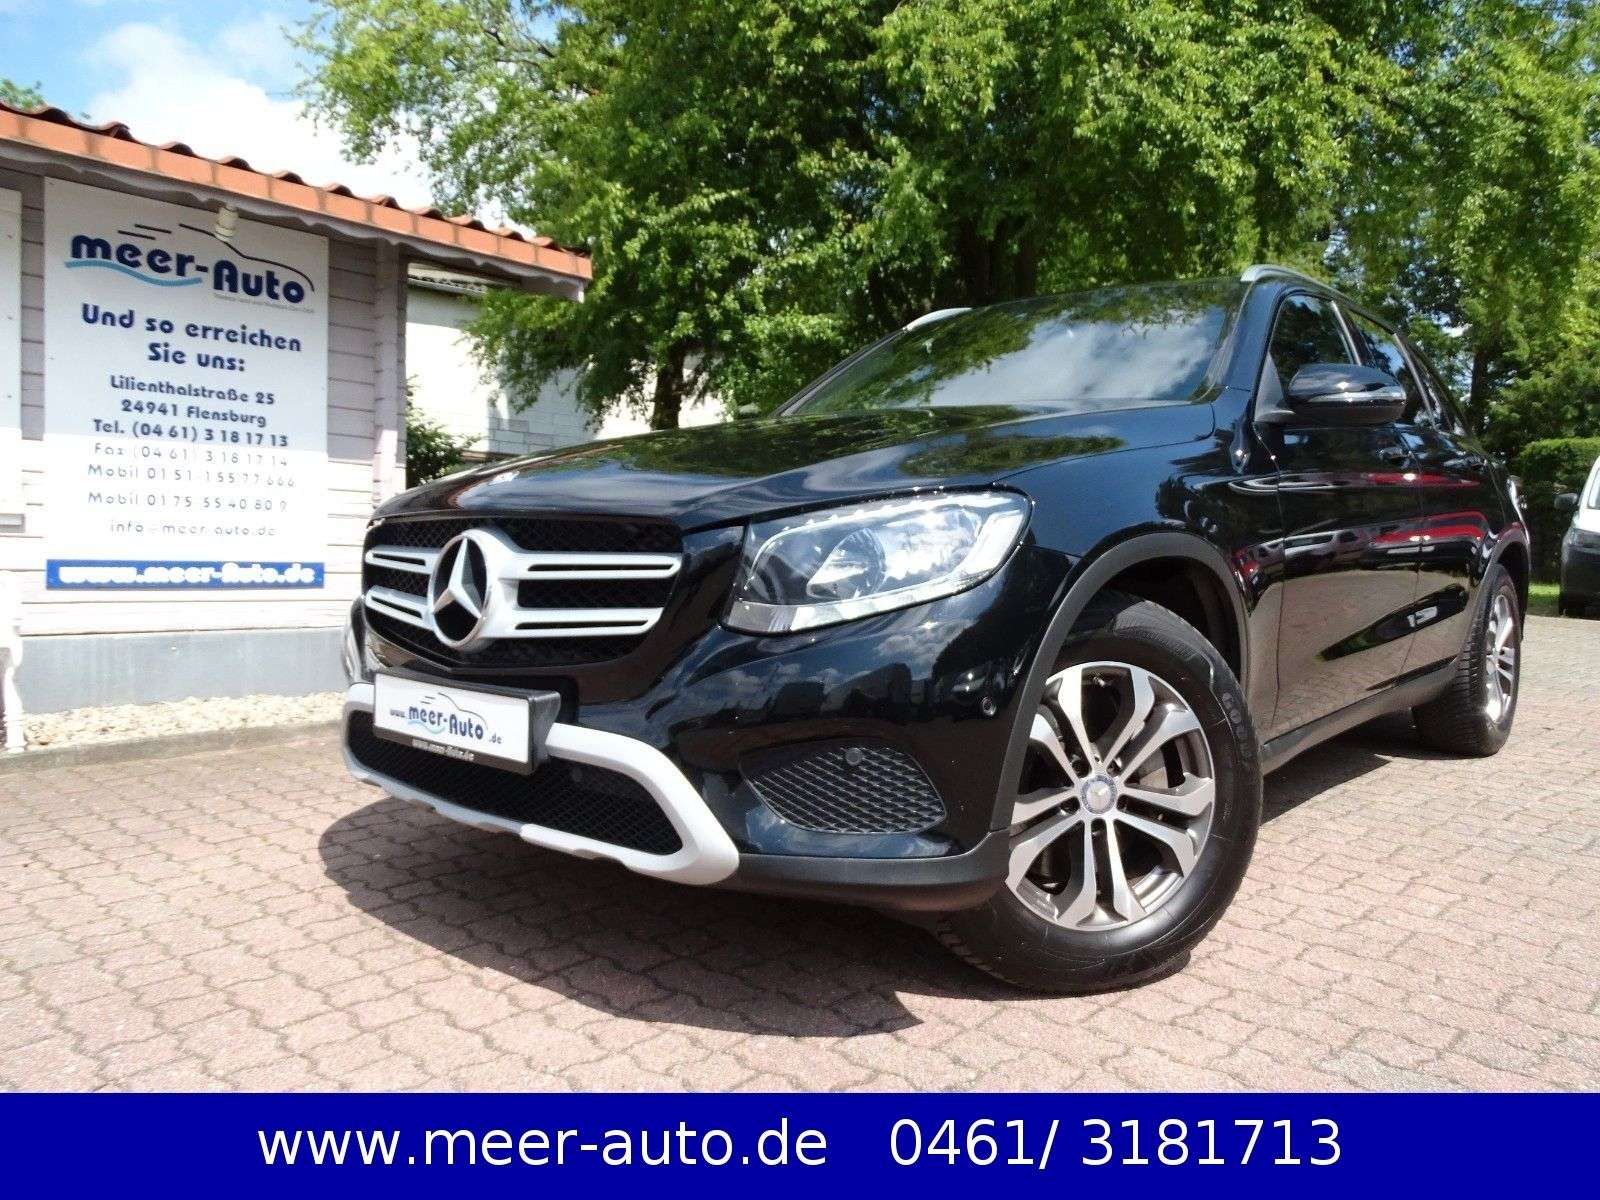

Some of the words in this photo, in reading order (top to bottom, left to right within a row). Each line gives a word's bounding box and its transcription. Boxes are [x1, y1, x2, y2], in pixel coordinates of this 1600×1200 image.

[71, 234, 305, 304] meer-Auto
[82, 303, 135, 329] Und
[145, 317, 175, 334] so
[185, 324, 302, 352] erreichen
[148, 342, 186, 365] Sie
[197, 351, 246, 372] uns:
[110, 374, 249, 402] Lilienthalstraße
[255, 391, 275, 406] 25
[93, 418, 125, 434] Tel.
[121, 399, 178, 417] 24941
[187, 405, 267, 429] Flensburg
[94, 442, 124, 456] Fax
[87, 464, 139, 480] Mobil
[87, 492, 139, 506] Mobil
[408, 705, 484, 740] meer-Auto
